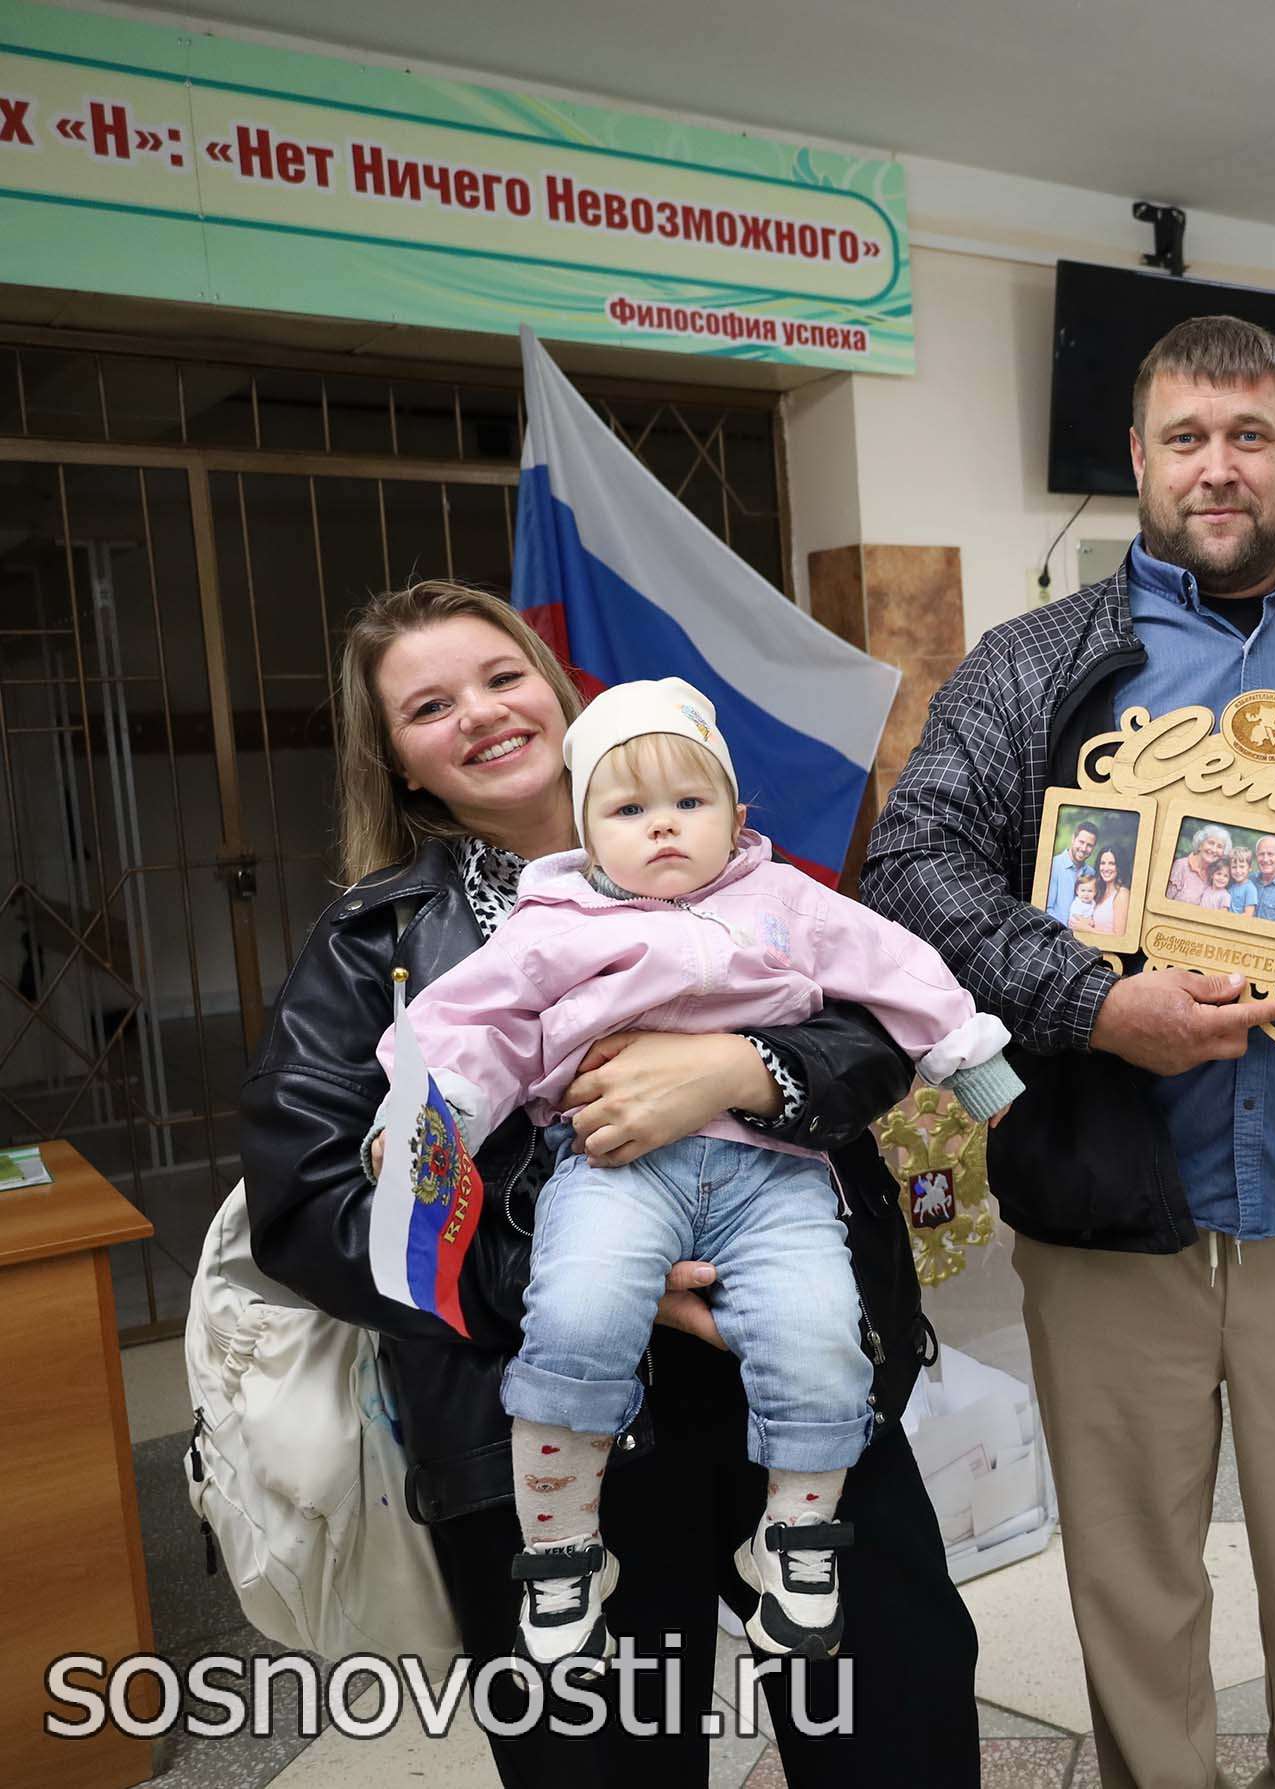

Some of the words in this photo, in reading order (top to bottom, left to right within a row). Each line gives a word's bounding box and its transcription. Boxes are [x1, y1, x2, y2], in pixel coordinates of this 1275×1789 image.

[56, 101, 184, 168] «Н»:
[205, 125, 334, 188] «Нет
[351, 143, 532, 217] Ничего
[545, 175, 881, 265] Невозможного»
[609, 297, 777, 340] Философия
[781, 321, 867, 351] успеха
